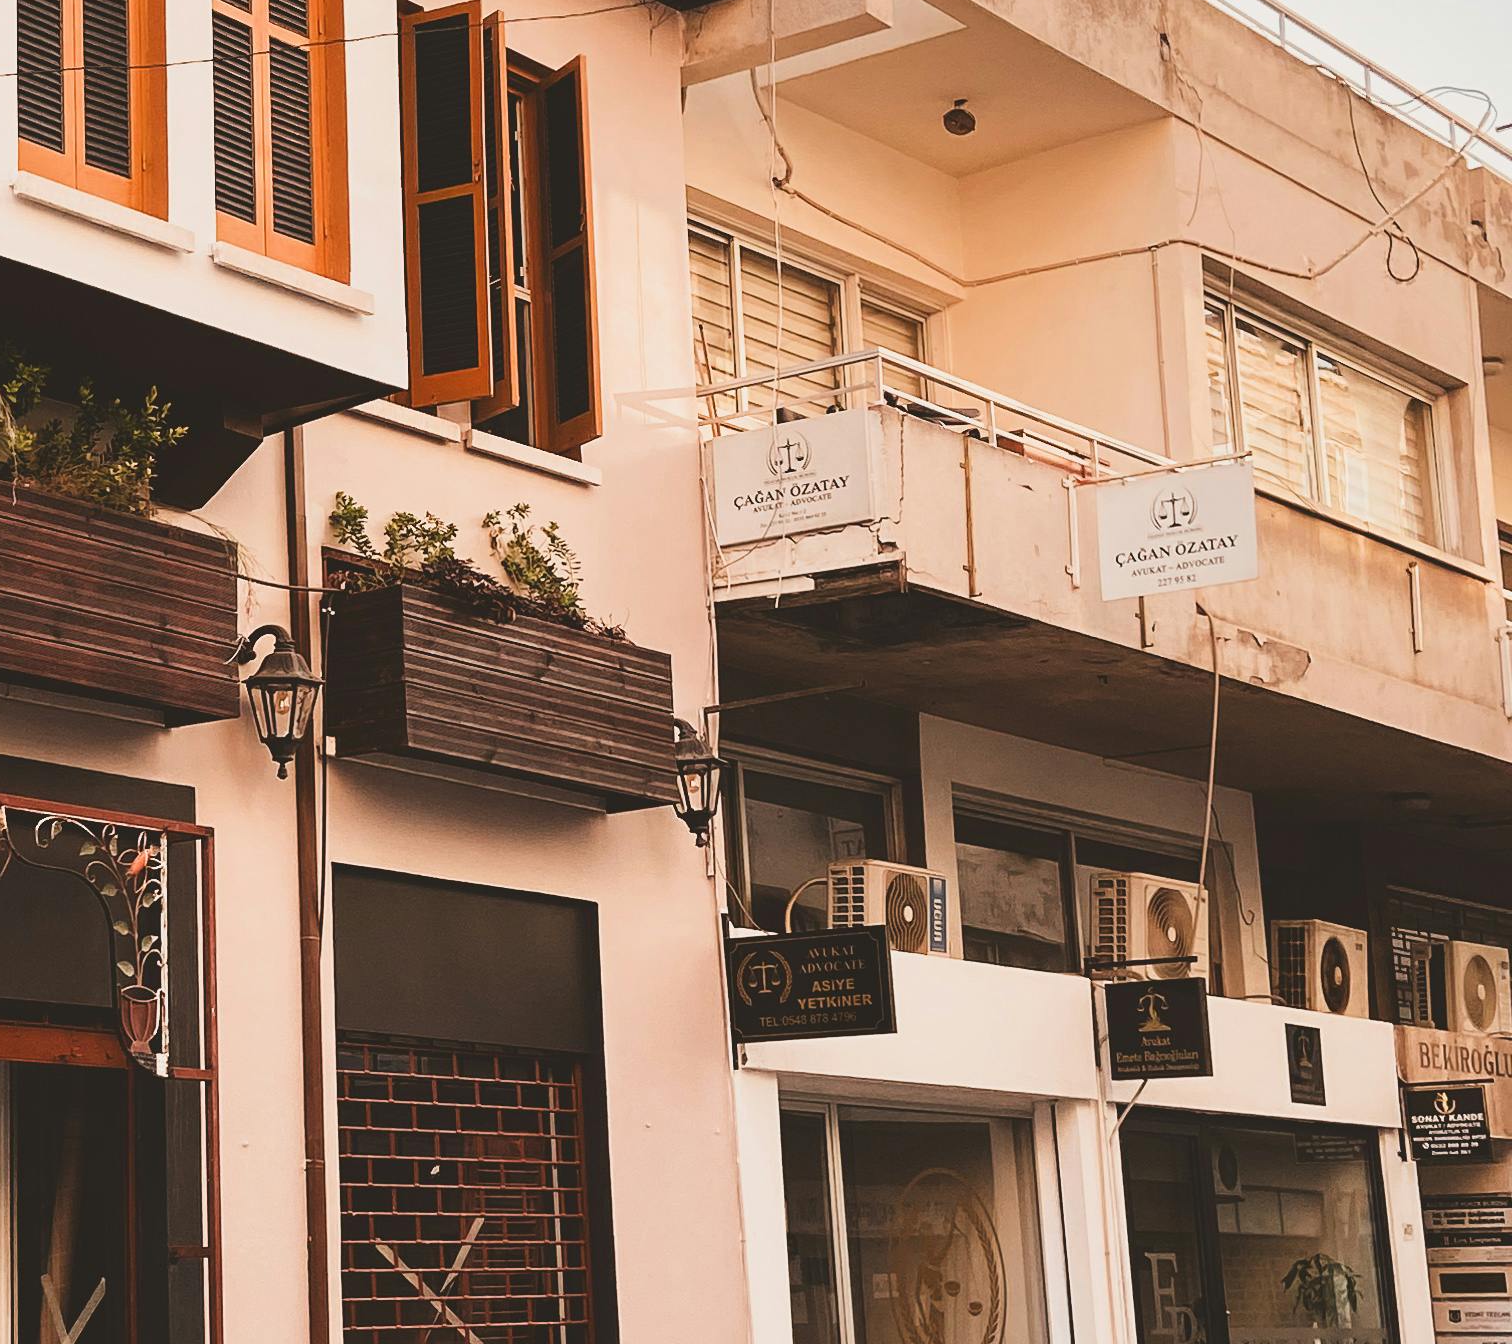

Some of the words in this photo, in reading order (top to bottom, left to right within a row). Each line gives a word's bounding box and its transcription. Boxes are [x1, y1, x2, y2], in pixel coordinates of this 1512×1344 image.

[790, 475, 850, 497] ÖZATAY
[790, 493, 832, 506] ADVOCATE
[1115, 544, 1170, 567] ÇAĞAN
[1175, 534, 1238, 556] ÖZATAY
[1131, 565, 1167, 577] AVUKAT
[1176, 556, 1225, 570] ADVOCATE
[1158, 578, 1172, 587] 227
[1174, 576, 1184, 584] 95
[1186, 574, 1197, 582] 82
[808, 945, 855, 959] AVUKAT
[800, 959, 865, 974] ADVOCATE
[1411, 1114, 1445, 1124] SONAY
